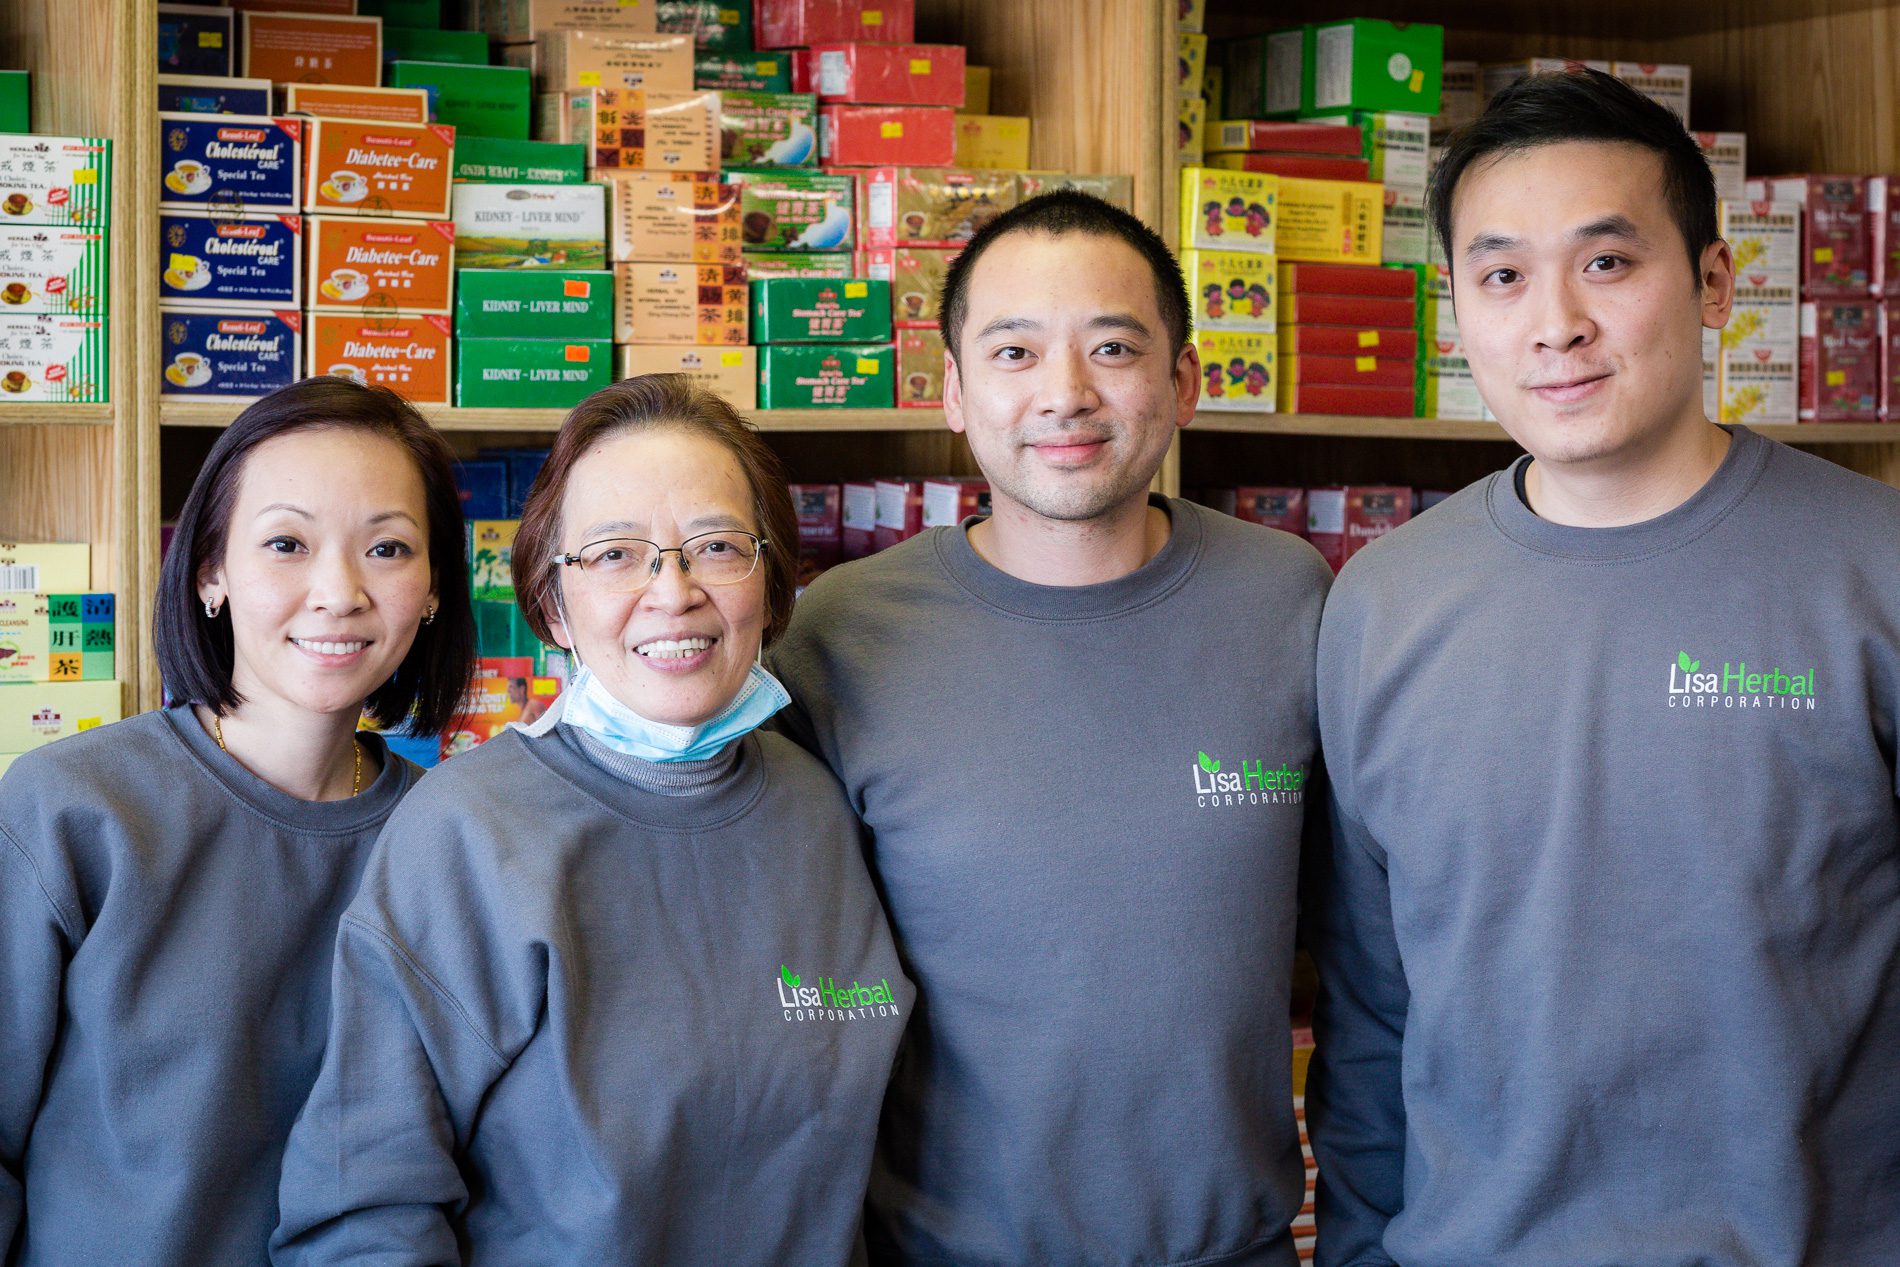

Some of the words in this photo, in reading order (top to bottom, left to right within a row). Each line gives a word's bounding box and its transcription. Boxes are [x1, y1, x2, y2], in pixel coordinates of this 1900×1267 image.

[474, 211, 514, 223] KIDNEY
[522, 211, 553, 223] LIVER
[555, 211, 581, 223] MIND
[482, 300, 522, 312] KIDNEY
[529, 300, 560, 313] LIVER
[562, 301, 589, 313] MIND
[482, 368, 522, 380] KIDNEY
[529, 368, 560, 381] LIVER
[562, 369, 588, 381] MIND
[1668, 695, 1815, 710] CORPORATION
[784, 1004, 900, 1022] CORPORATION
